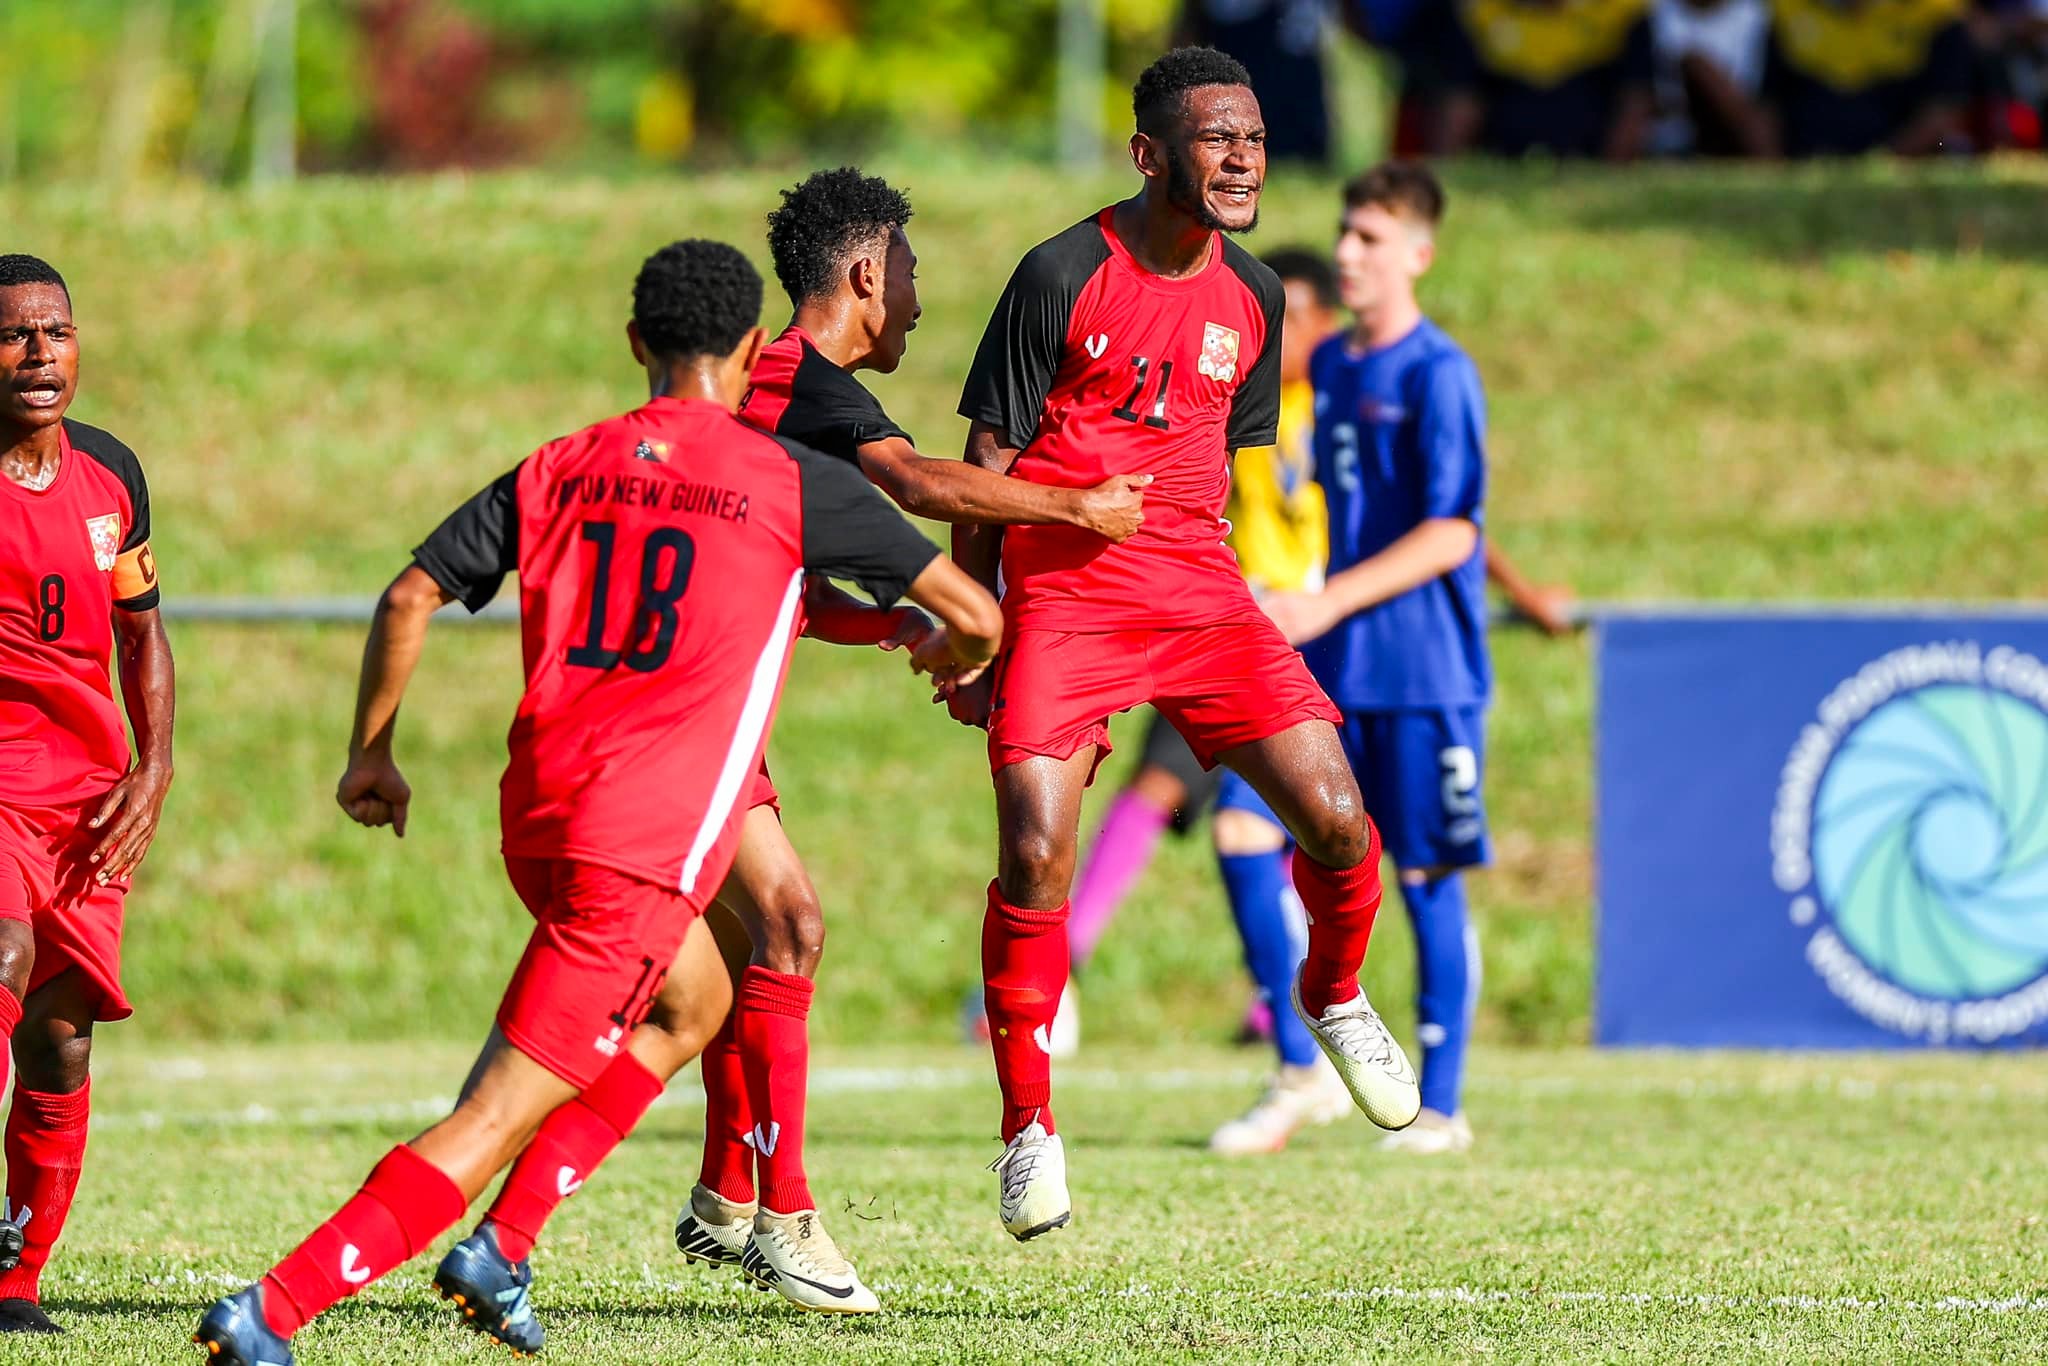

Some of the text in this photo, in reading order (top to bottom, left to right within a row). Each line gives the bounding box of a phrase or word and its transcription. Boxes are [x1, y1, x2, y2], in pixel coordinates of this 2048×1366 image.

[1112, 356, 1173, 430] 11
[611, 474, 667, 508] NEW
[670, 482, 749, 524] GUINEA
[137, 546, 155, 584] C
[566, 521, 695, 673] 18
[40, 574, 65, 642] 8
[1439, 746, 1477, 817] 2
[1770, 721, 1836, 892] OCEANIA
[1817, 638, 1981, 733] FOOTBALL
[1805, 925, 1949, 1043] WOMEN'S
